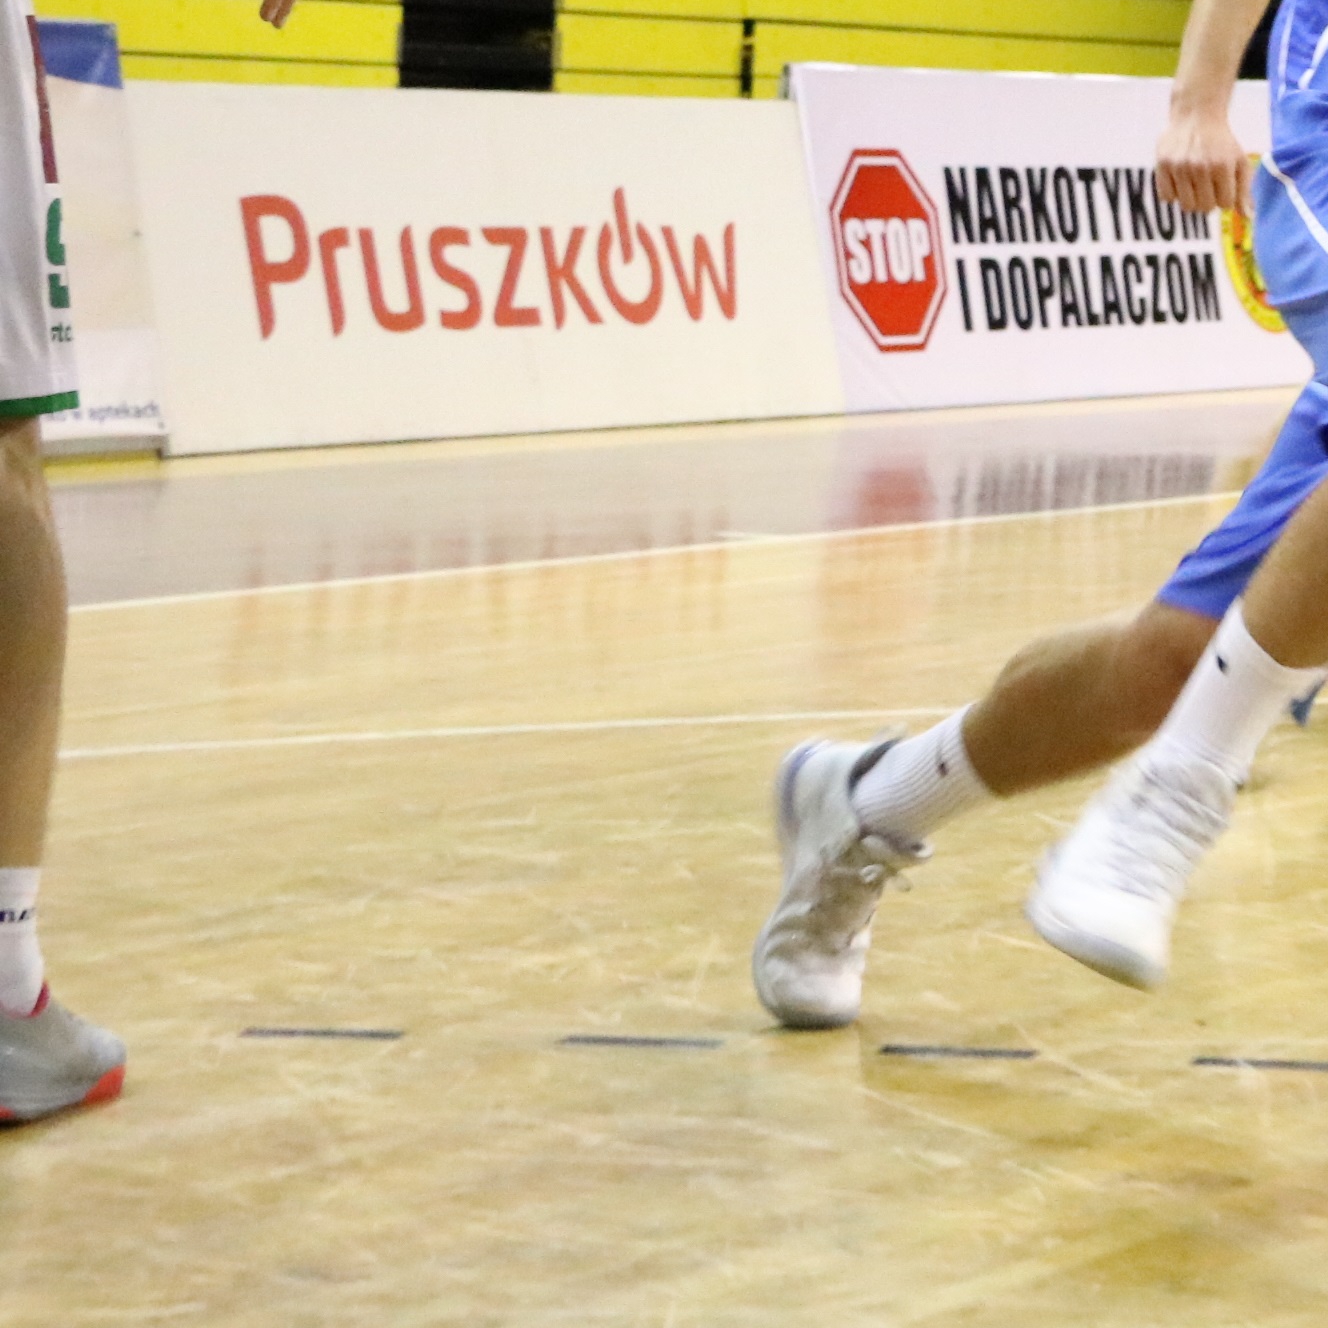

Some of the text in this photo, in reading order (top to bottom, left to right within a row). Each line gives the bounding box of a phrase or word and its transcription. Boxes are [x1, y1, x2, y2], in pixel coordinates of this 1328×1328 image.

[843, 216, 933, 285] STOP
[955, 252, 1222, 332] I DOPALACZOM
